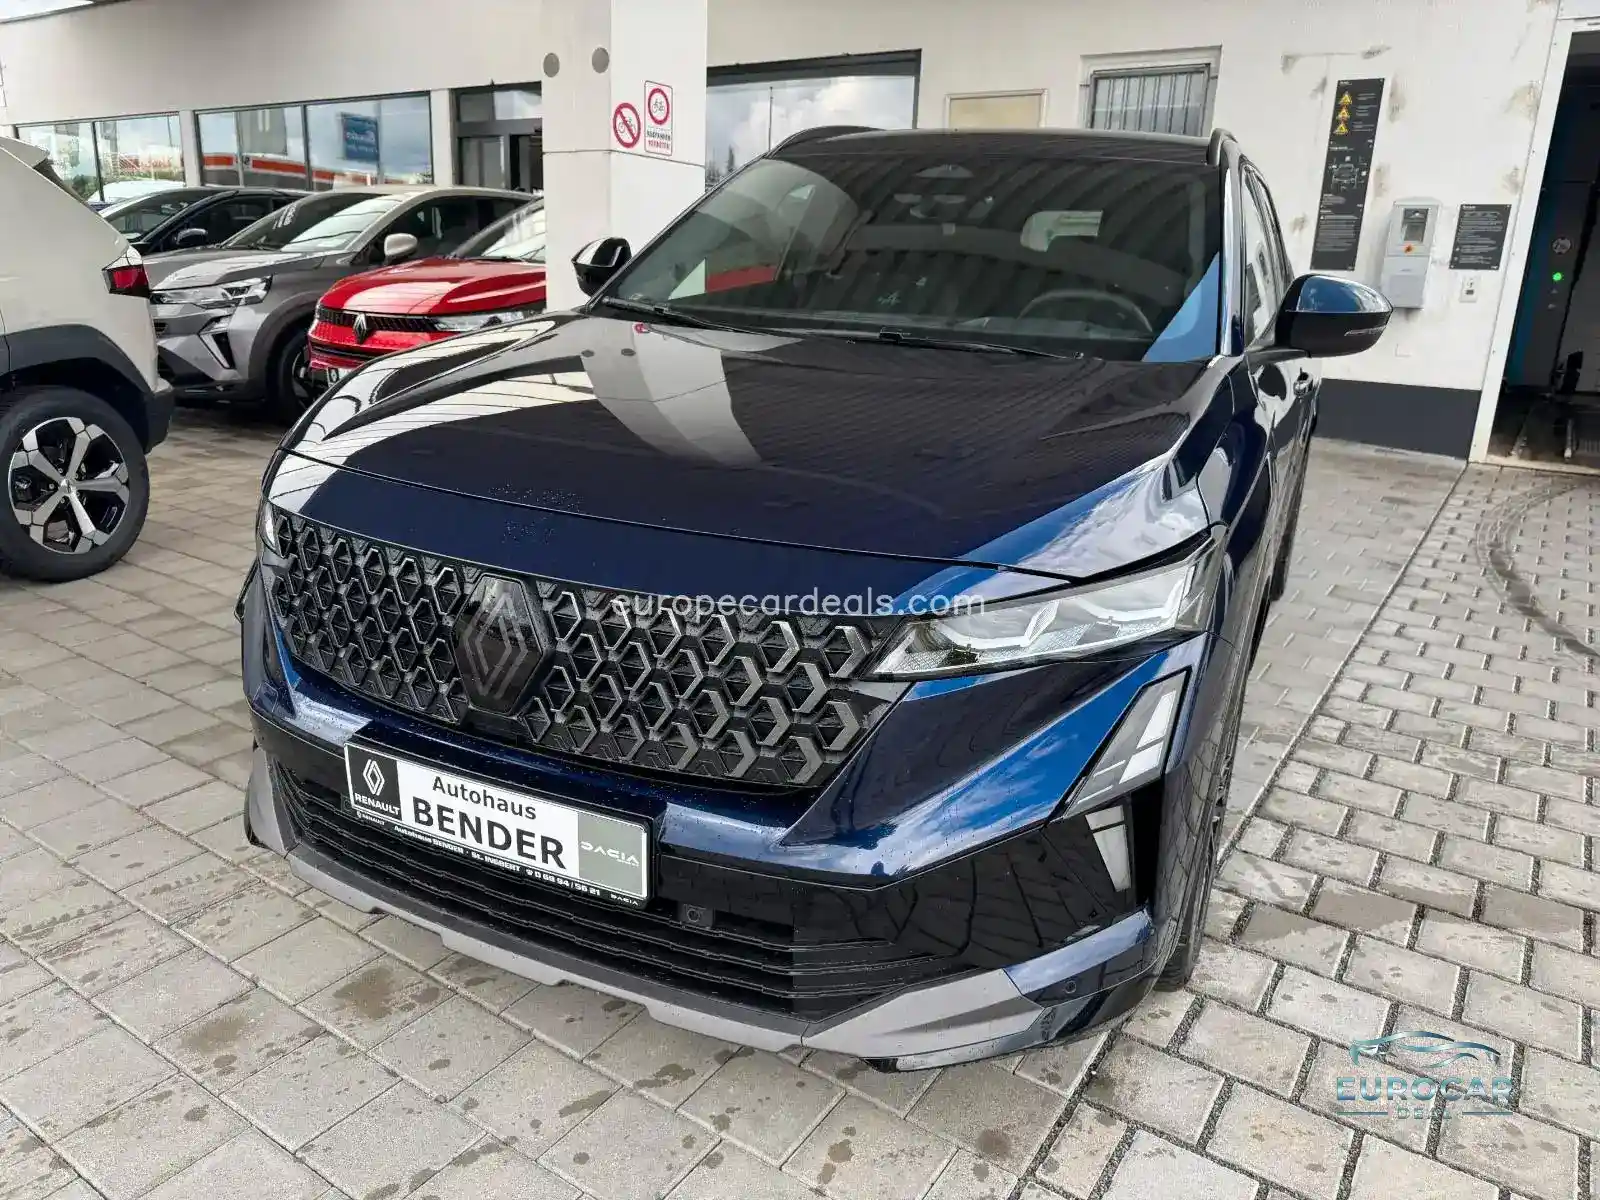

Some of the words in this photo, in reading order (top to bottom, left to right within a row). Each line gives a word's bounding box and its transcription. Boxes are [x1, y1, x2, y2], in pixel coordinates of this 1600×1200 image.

[354, 792, 400, 816] RENAULT
[432, 775, 537, 820] Autohaus
[412, 796, 567, 870] BENDER
[579, 841, 640, 865] DACIA
